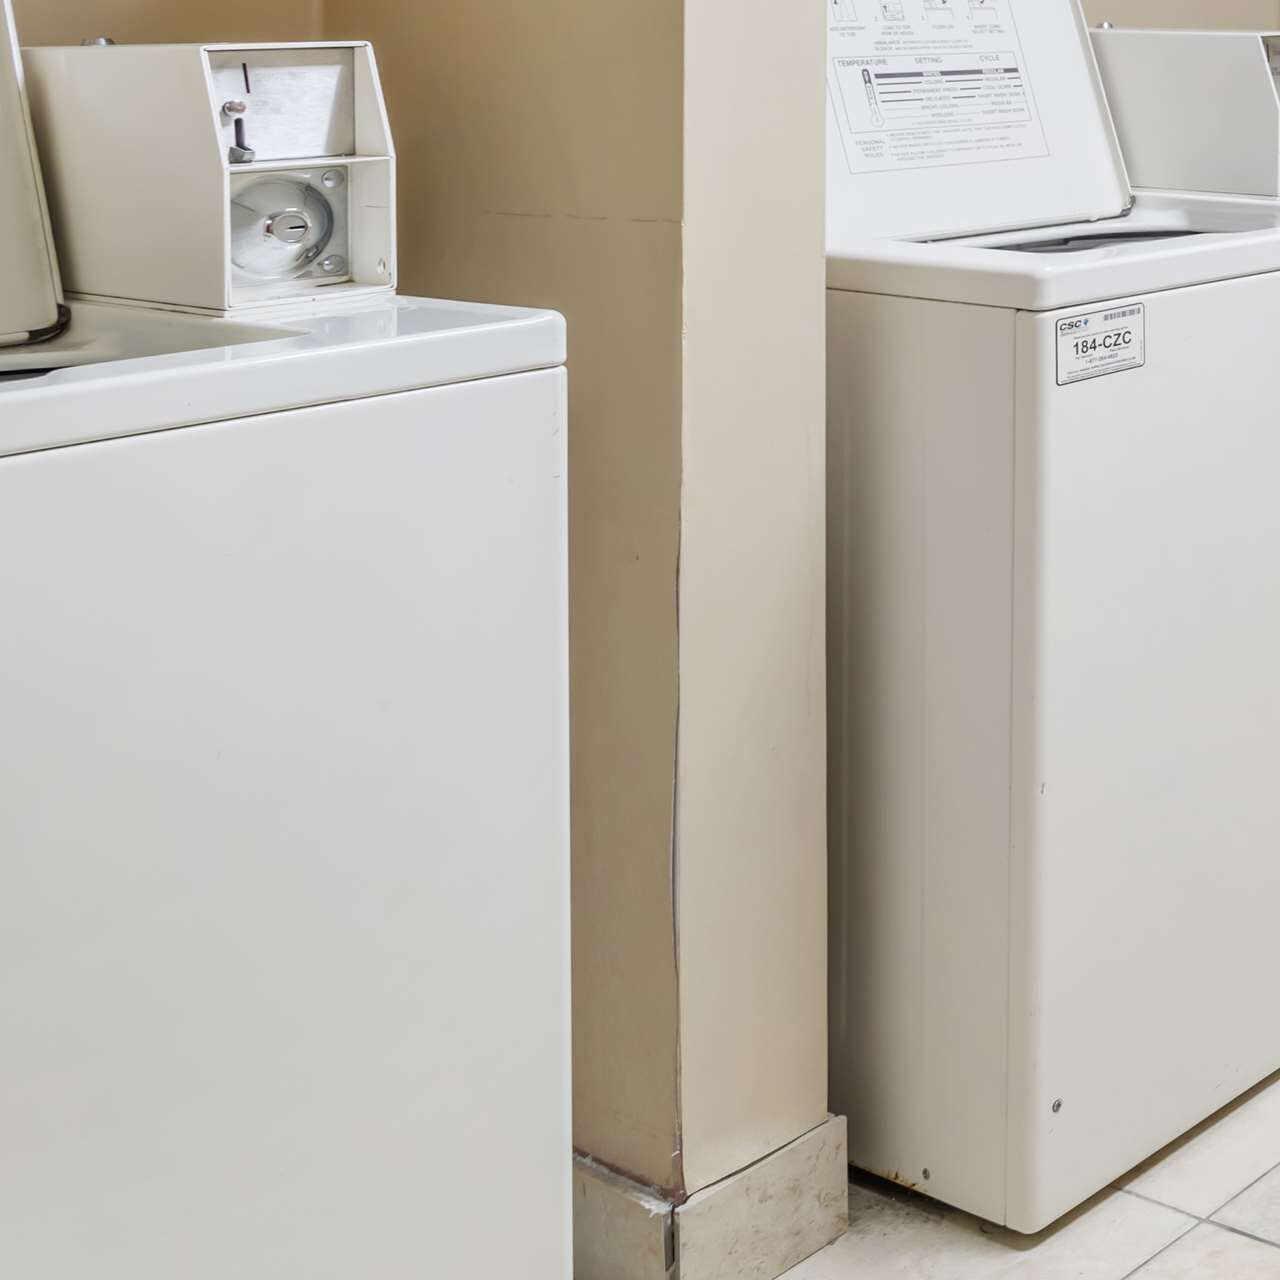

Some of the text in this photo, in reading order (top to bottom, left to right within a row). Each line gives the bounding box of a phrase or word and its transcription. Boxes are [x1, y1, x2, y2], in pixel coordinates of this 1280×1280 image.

[837, 59, 887, 67] TEMPERATURE
[1059, 320, 1082, 331] CSC
[1073, 330, 1132, 355] 184-CZC
